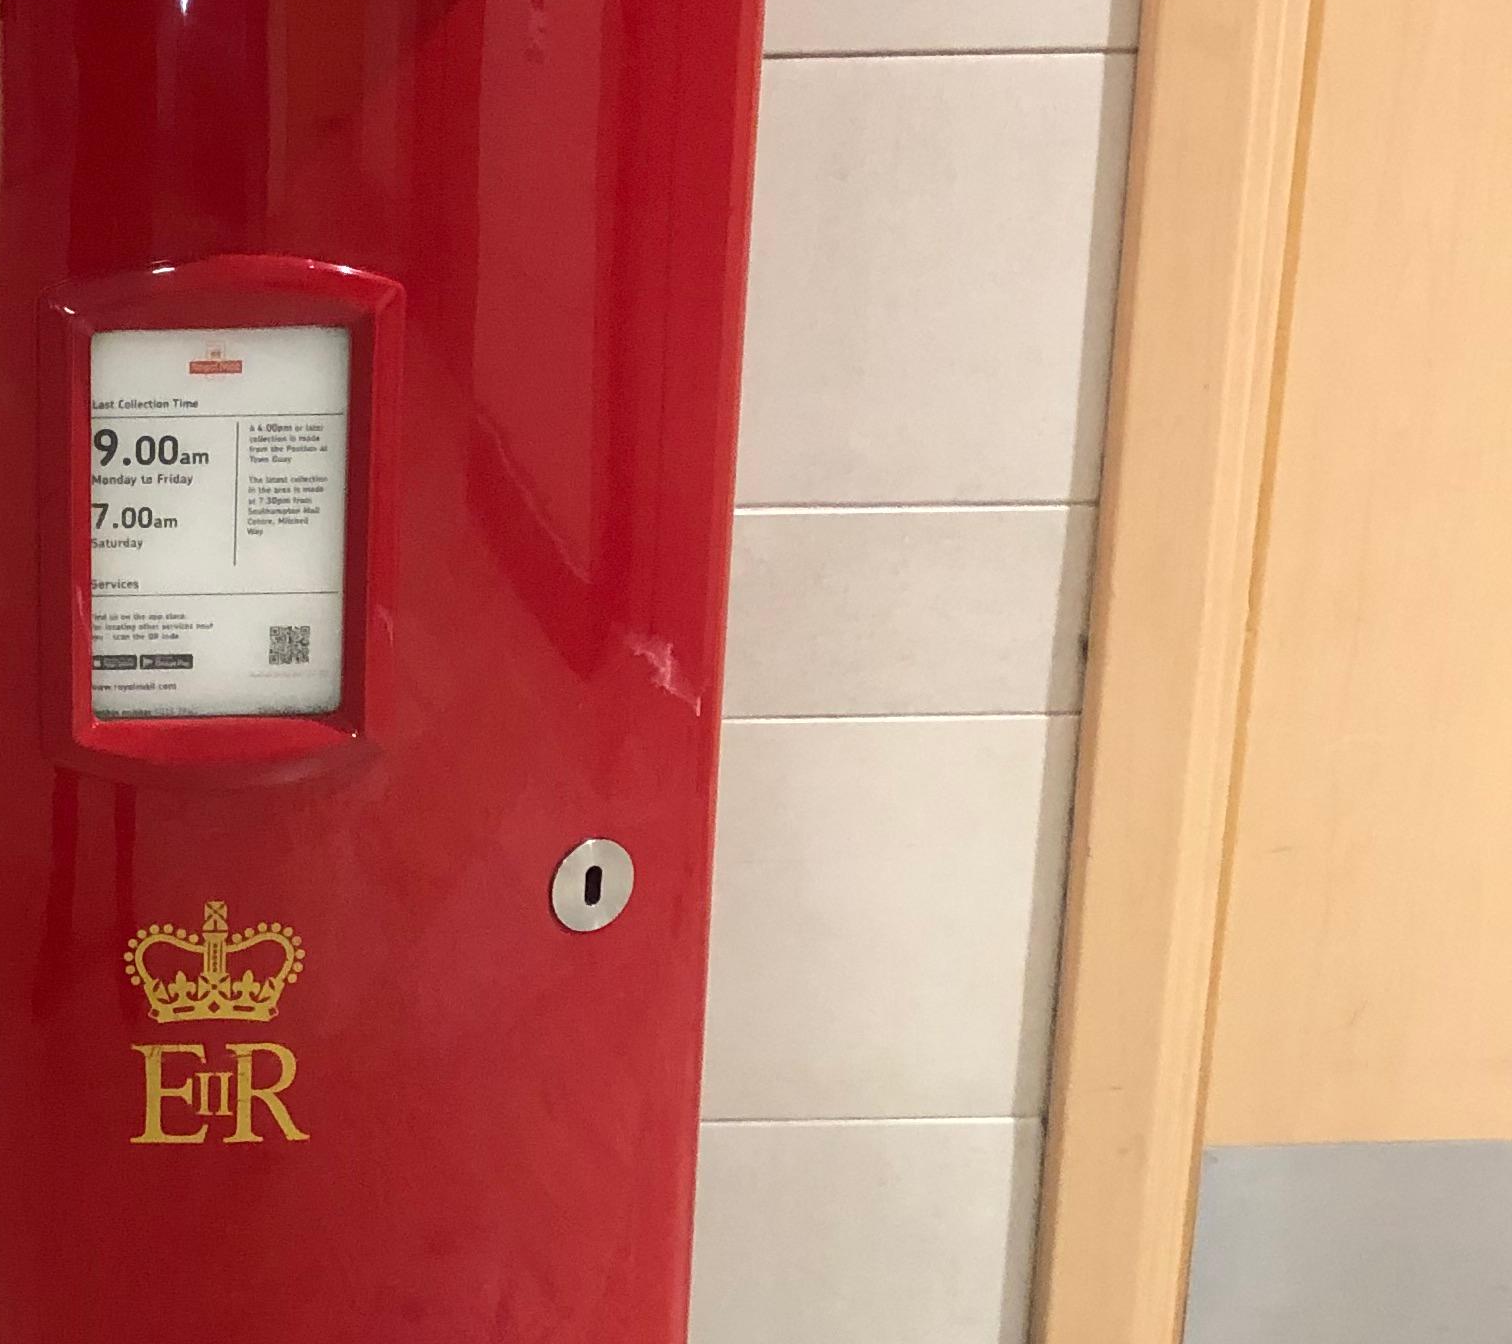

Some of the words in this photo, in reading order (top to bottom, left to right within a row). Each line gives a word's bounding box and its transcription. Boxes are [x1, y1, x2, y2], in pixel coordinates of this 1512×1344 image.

[92, 400, 115, 410] Last
[118, 399, 169, 409] Collection
[173, 398, 199, 409] Time
[93, 428, 210, 467] 9.00am
[91, 475, 137, 486] Monday
[141, 475, 153, 485] to
[157, 474, 194, 486] Friday
[91, 503, 178, 530] 7.00am
[91, 538, 144, 550] Saturday
[91, 578, 140, 590] Services
